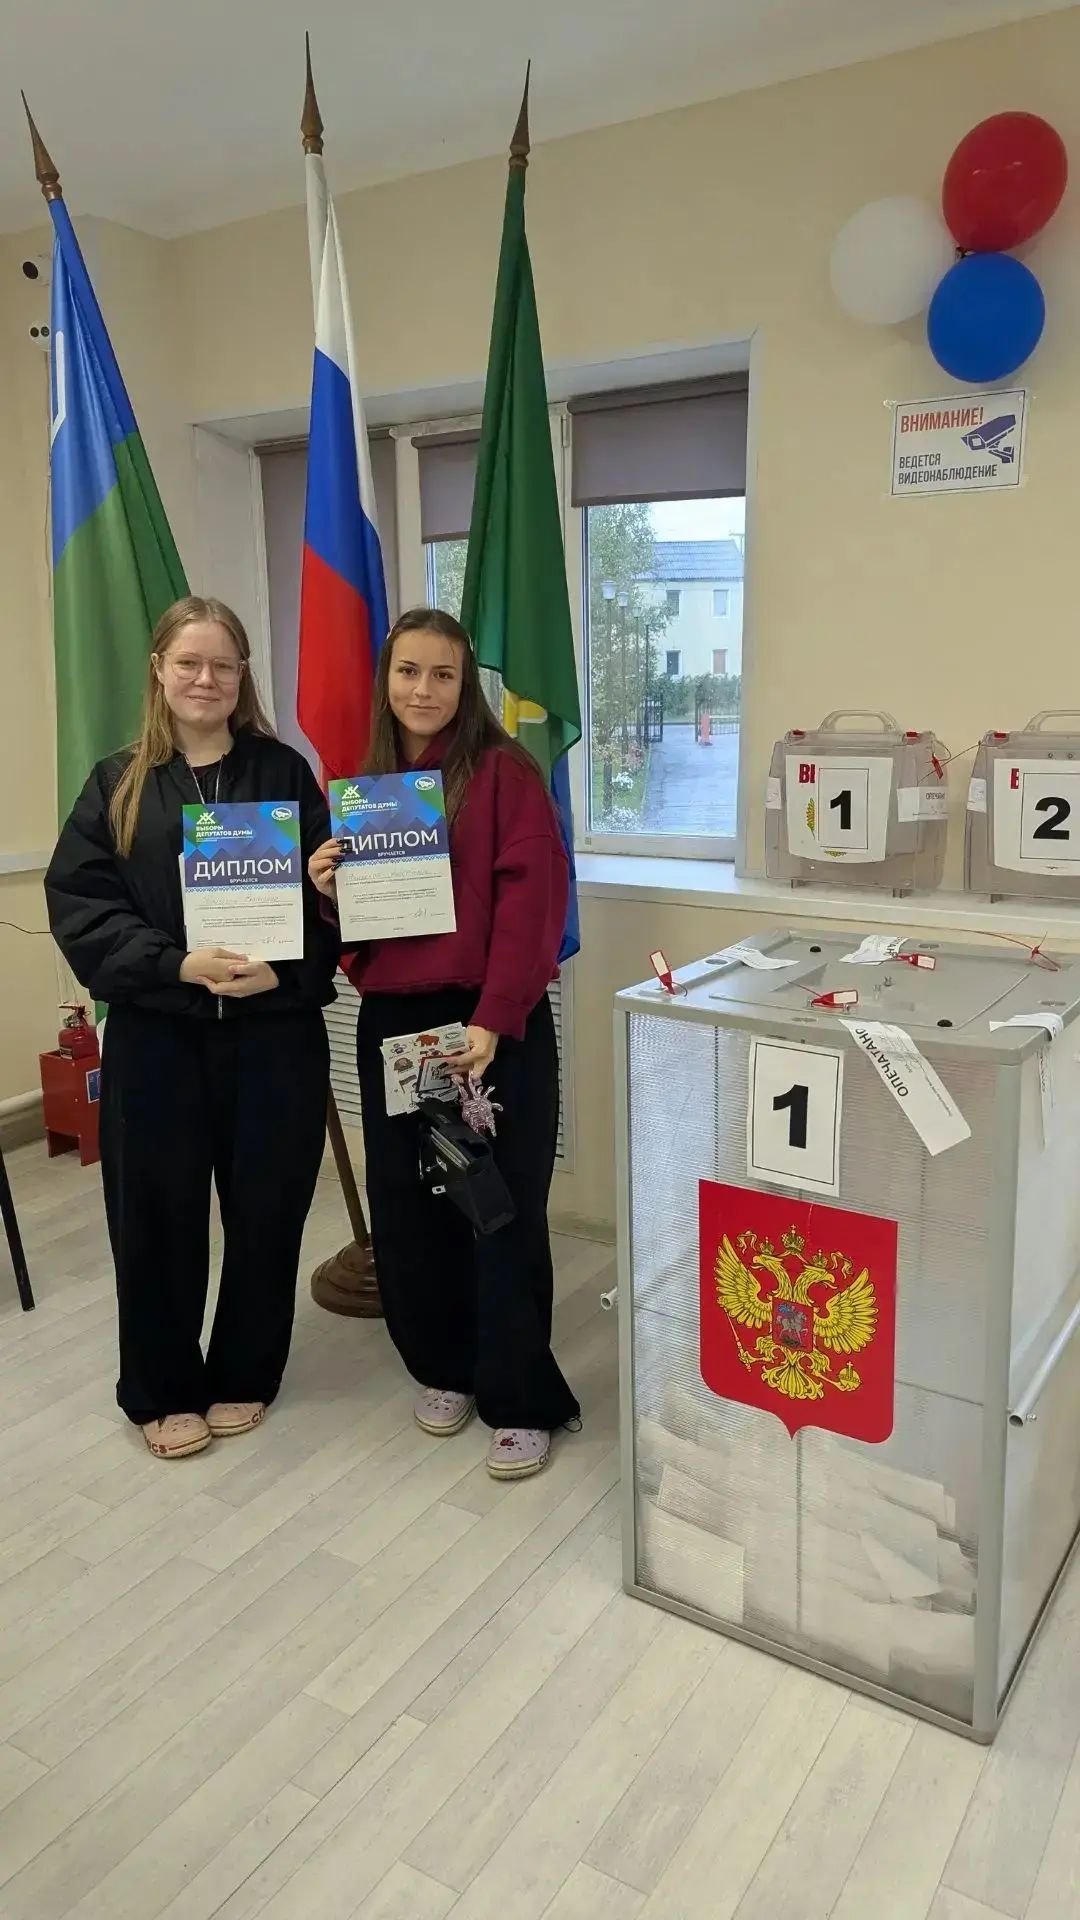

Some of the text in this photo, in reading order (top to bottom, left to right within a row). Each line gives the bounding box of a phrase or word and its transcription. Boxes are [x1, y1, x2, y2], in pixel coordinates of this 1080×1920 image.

[901, 407, 984, 433] ВНИМАНИЕ!
[899, 453, 941, 469] ВЕДЕТСЯ
[898, 464, 998, 485] ВИДЕОНАБЛЮДЕНИЕ
[341, 798, 368, 806] ВЫБОРЫ
[830, 790, 852, 830] 1
[1033, 796, 1071, 840] 2
[343, 828, 439, 855] ДИПЛОМ
[194, 858, 292, 881] ДИПЛОМ
[772, 1084, 809, 1149] 1
